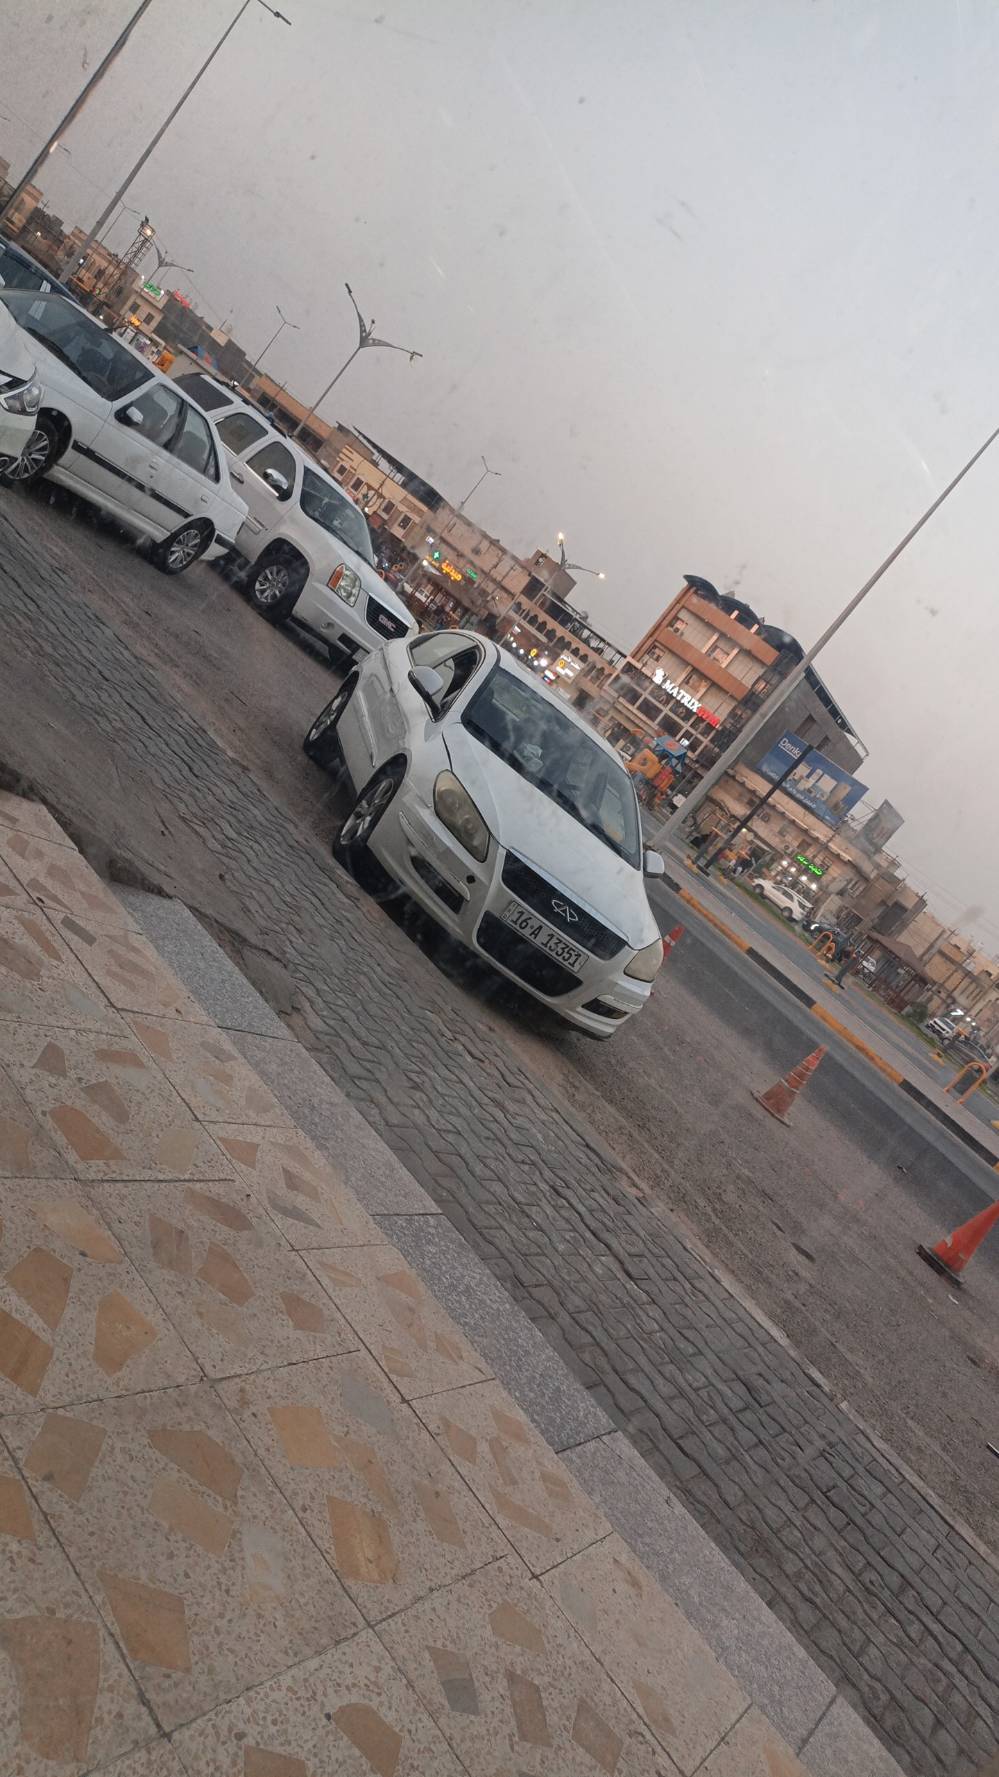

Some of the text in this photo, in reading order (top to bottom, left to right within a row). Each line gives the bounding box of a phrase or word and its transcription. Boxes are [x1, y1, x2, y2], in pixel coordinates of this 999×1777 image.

[661, 679, 702, 713] MATRIX
[511, 910, 532, 930] 16
[529, 925, 543, 940] A
[541, 933, 582, 968] 13351
